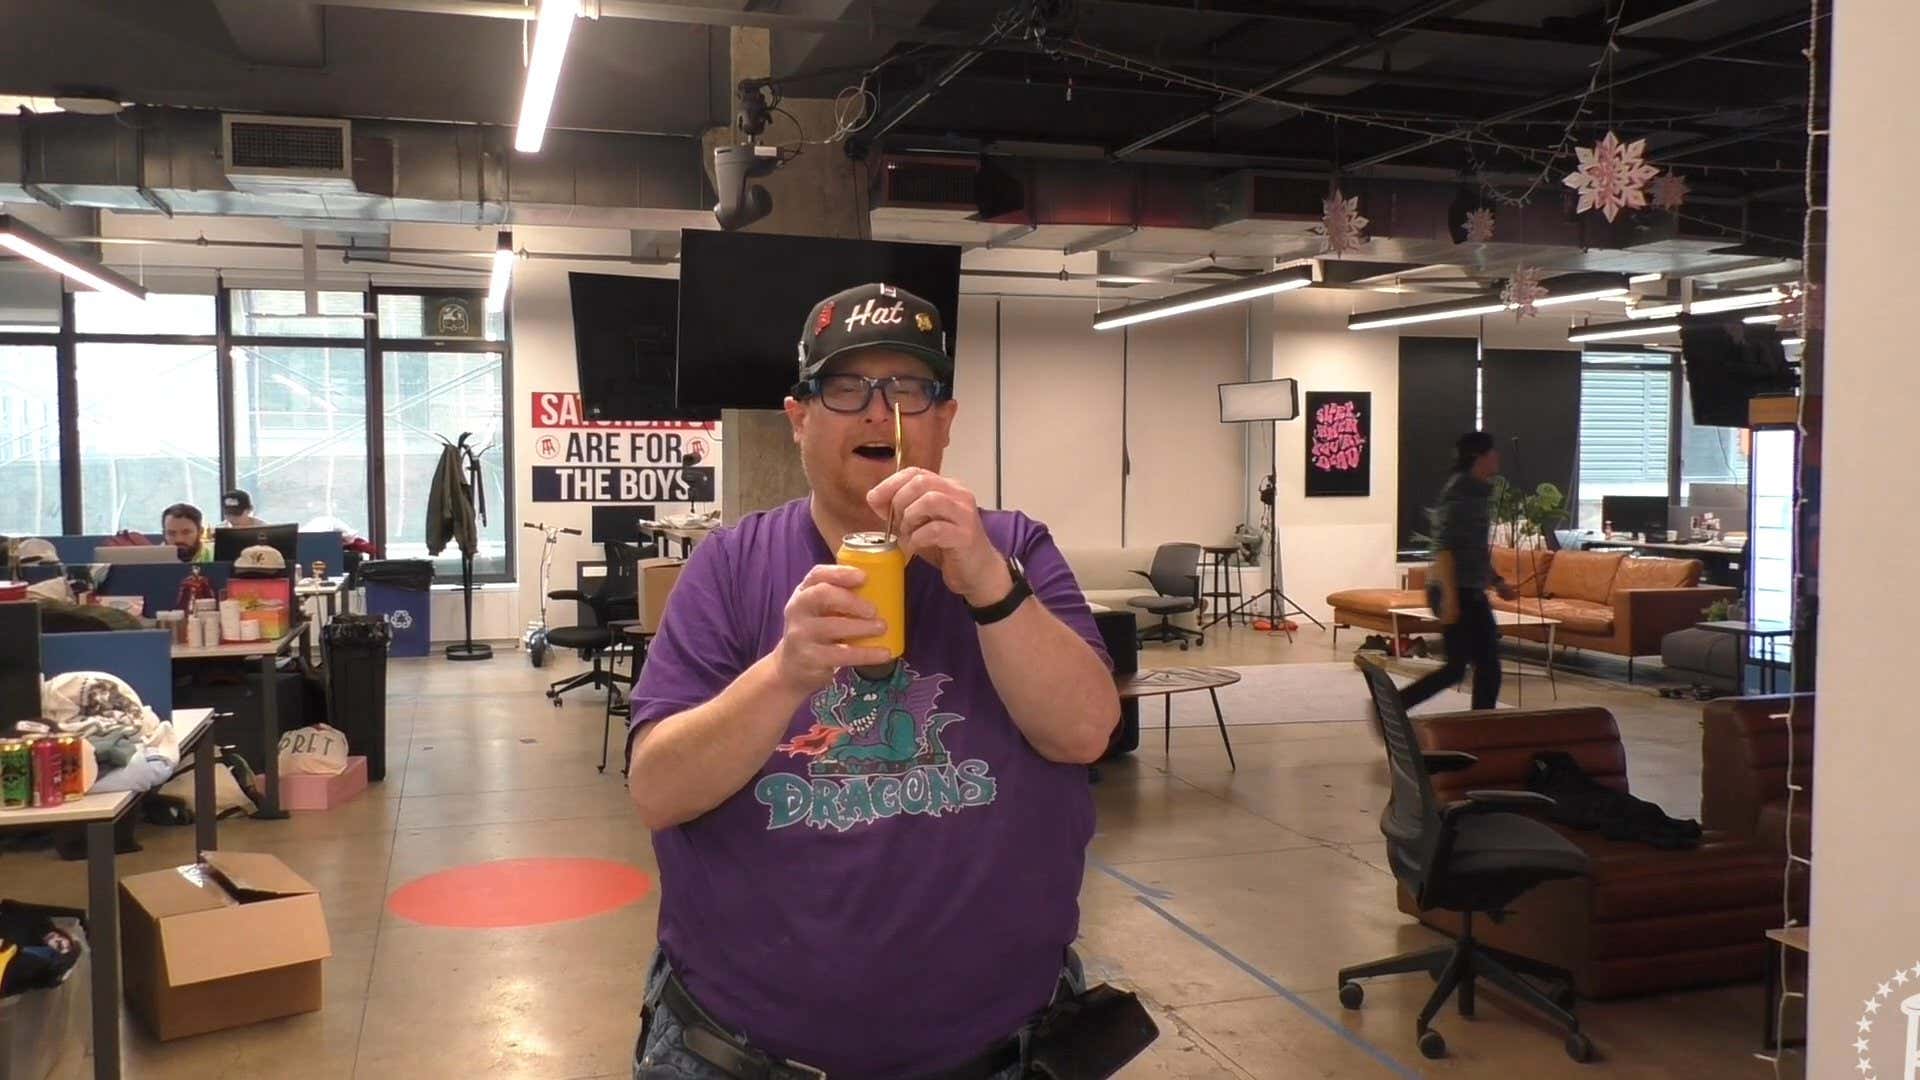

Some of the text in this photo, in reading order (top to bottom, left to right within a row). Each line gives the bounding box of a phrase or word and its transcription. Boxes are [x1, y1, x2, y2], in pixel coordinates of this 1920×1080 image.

[845, 299, 904, 332] Hat
[565, 432, 682, 464] ARE FOR
[555, 468, 612, 500] THE
[754, 759, 997, 832] DRAGONS
